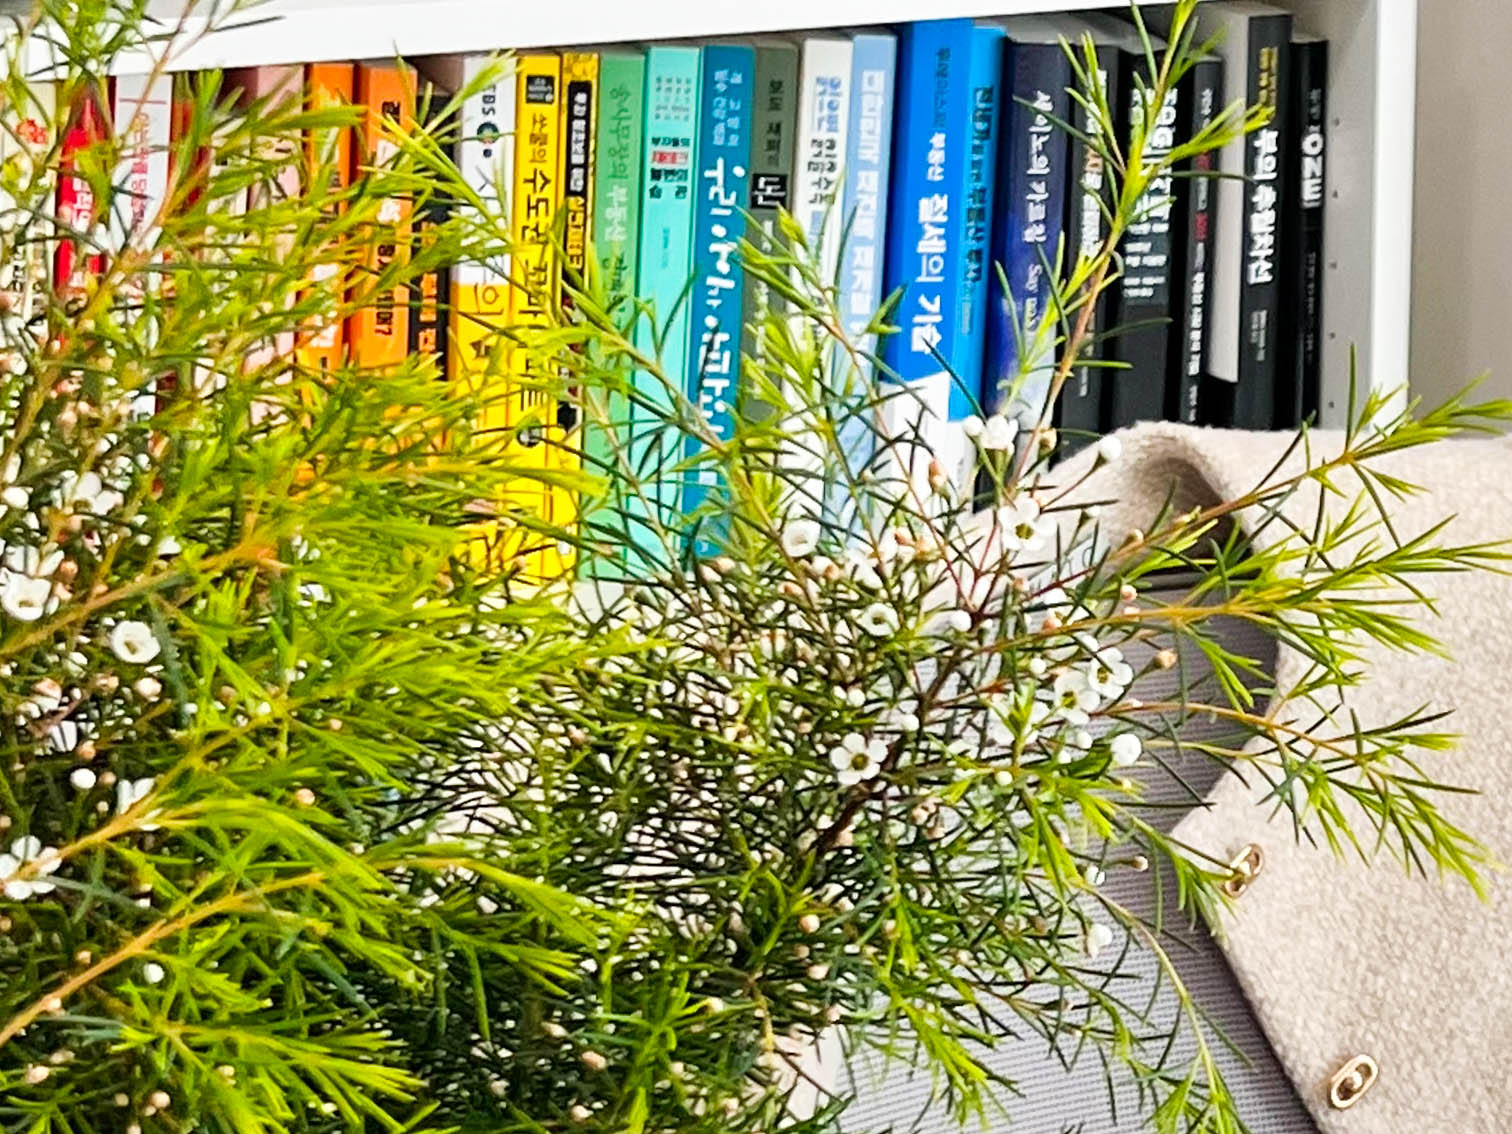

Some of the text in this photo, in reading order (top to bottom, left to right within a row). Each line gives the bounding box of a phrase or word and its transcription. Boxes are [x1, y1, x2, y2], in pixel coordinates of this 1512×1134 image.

[926, 132, 946, 182] 부동산
[1024, 90, 1053, 244] 세이노의 가르침
[1254, 128, 1279, 182] 부의
[524, 169, 550, 244] 수도권
[605, 185, 626, 242] 부동산
[707, 156, 744, 218] 우리
[916, 193, 949, 284] 절세의
[1247, 184, 1276, 286] 추월차선
[912, 293, 942, 355] 기술
